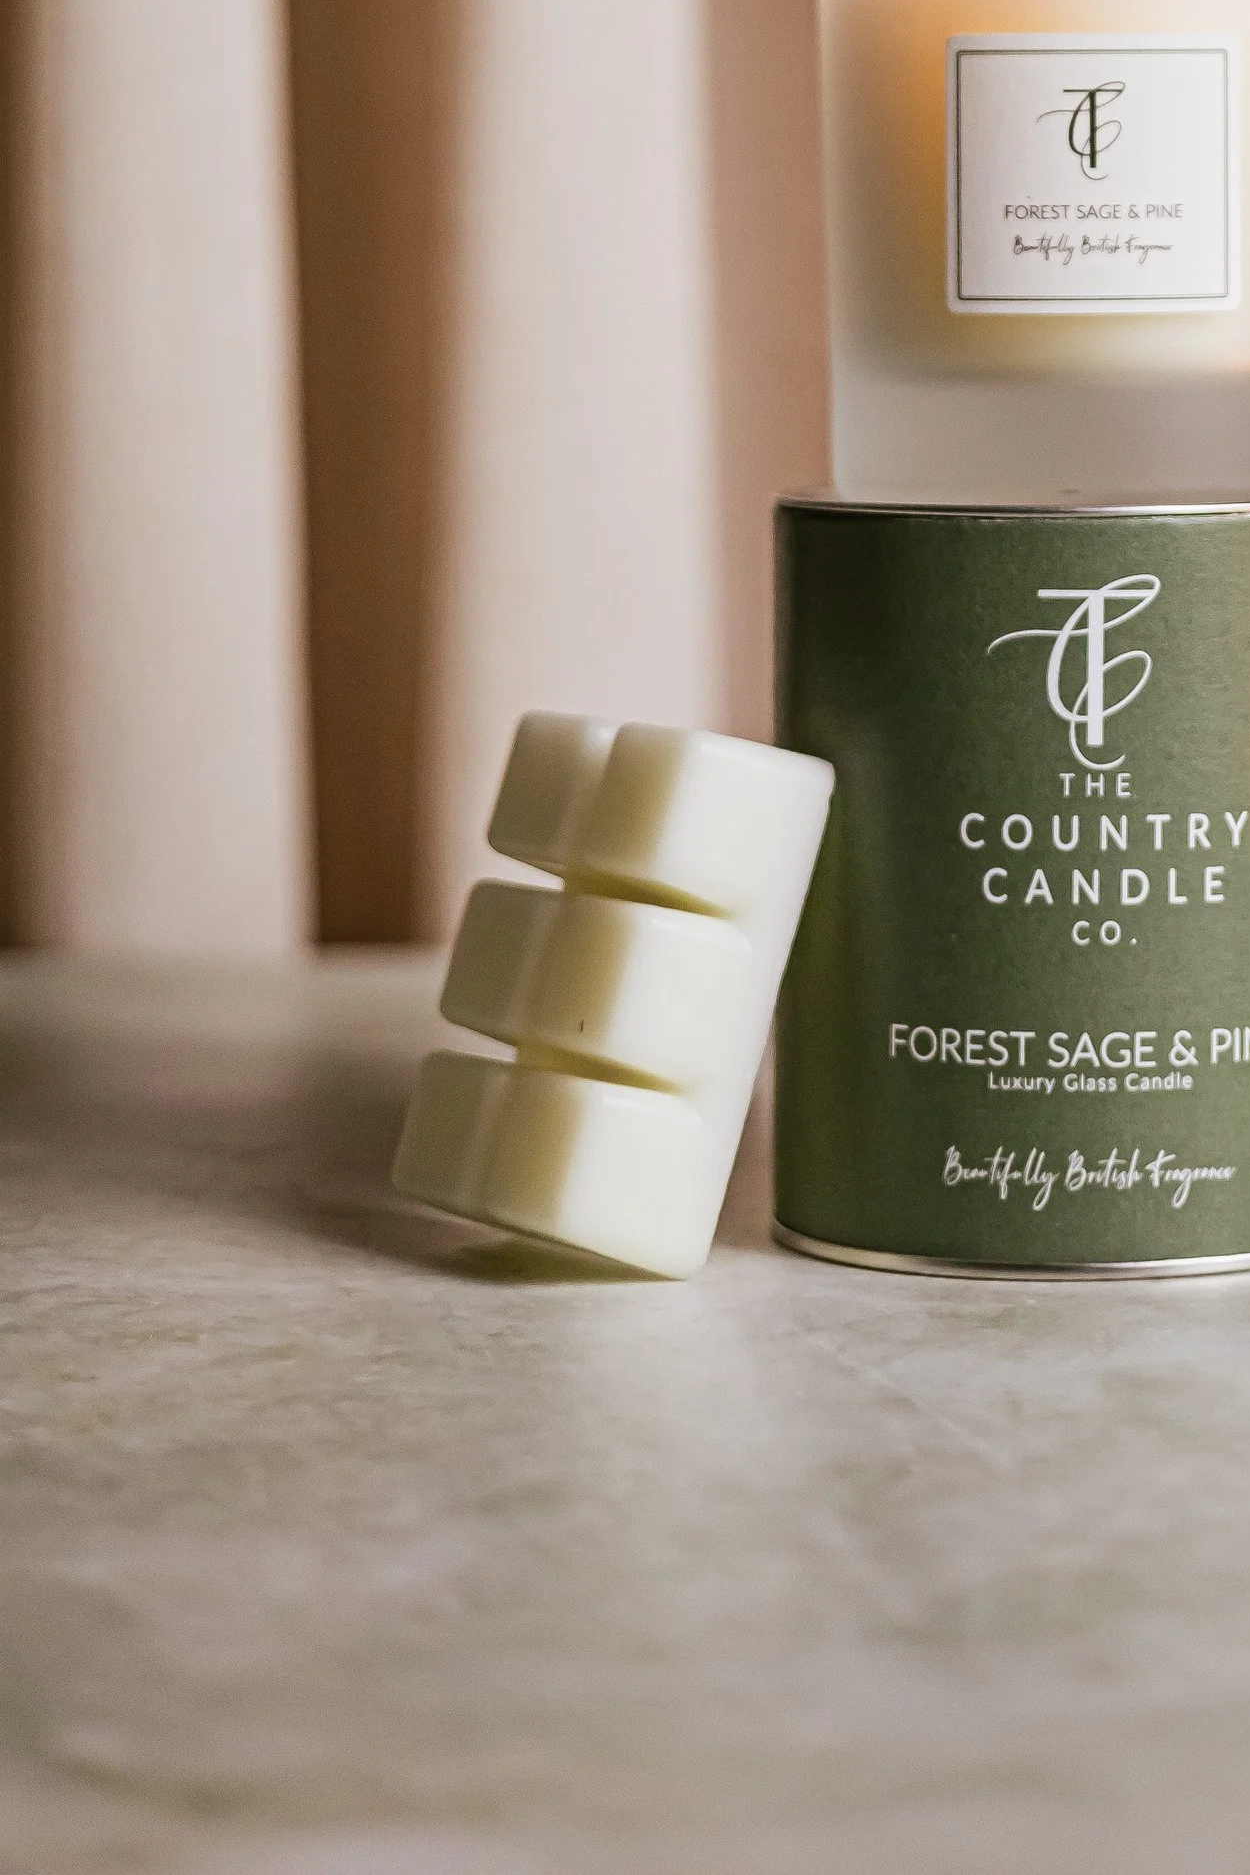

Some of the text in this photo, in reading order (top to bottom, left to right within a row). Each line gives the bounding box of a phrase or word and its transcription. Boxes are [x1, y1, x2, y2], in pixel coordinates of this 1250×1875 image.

[1004, 202, 1185, 221] FOREST SAGE & PINE
[1059, 772, 1131, 798] THE
[960, 810, 1249, 852] COUNTRY
[982, 865, 1225, 906] CANDLE
[1071, 920, 1137, 947] CO.
[889, 1022, 1037, 1068] FOREST
[1047, 1030, 1157, 1069] SAGE
[1168, 1029, 1199, 1067] &
[989, 1070, 1194, 1095] Luxury Glass Candle
[942, 1145, 1059, 1212] Beautifully
[1064, 1147, 1143, 1192] British
